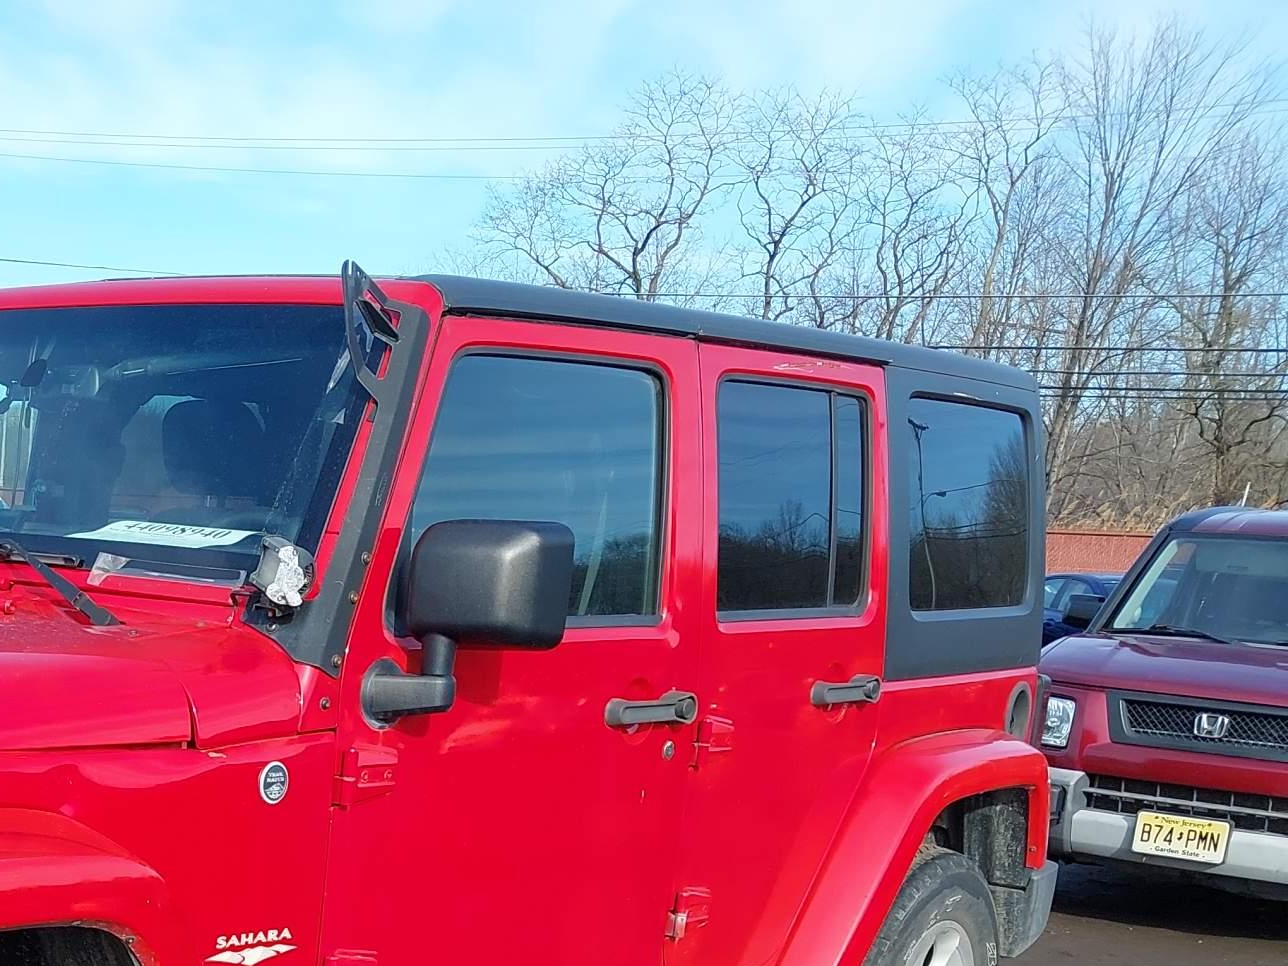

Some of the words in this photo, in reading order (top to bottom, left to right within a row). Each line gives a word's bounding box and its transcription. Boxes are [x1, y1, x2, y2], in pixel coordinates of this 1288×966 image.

[1161, 816, 1180, 825] New
[1181, 819, 1208, 829] Jersey
[1154, 846, 1180, 855] Garden
[1181, 849, 1201, 858] State
[216, 927, 292, 949] SAHARA
